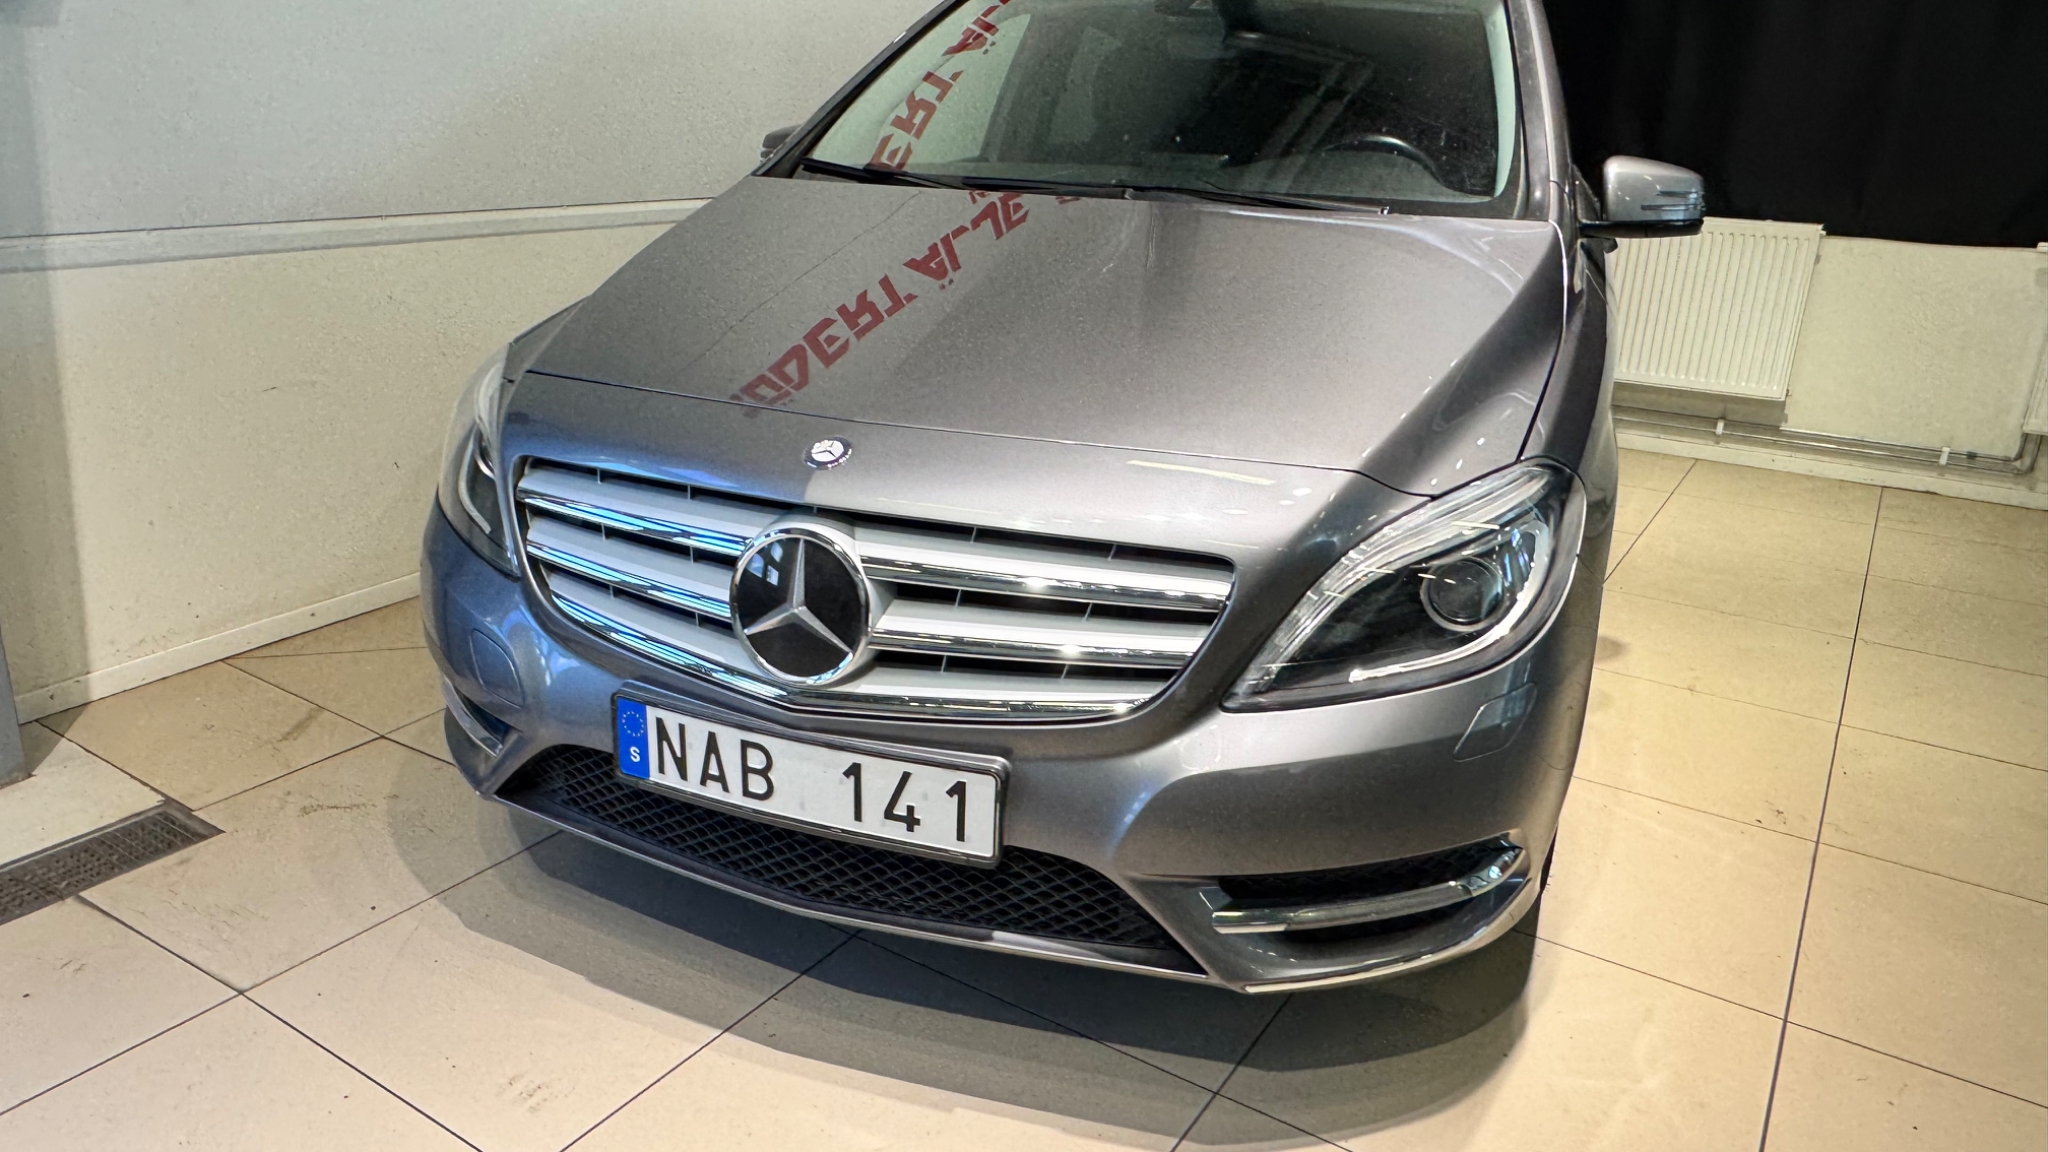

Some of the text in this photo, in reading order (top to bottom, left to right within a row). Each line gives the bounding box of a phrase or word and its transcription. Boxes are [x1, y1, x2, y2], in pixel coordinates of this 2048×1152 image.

[630, 746, 641, 763] S
[655, 716, 967, 843] NAB 141
